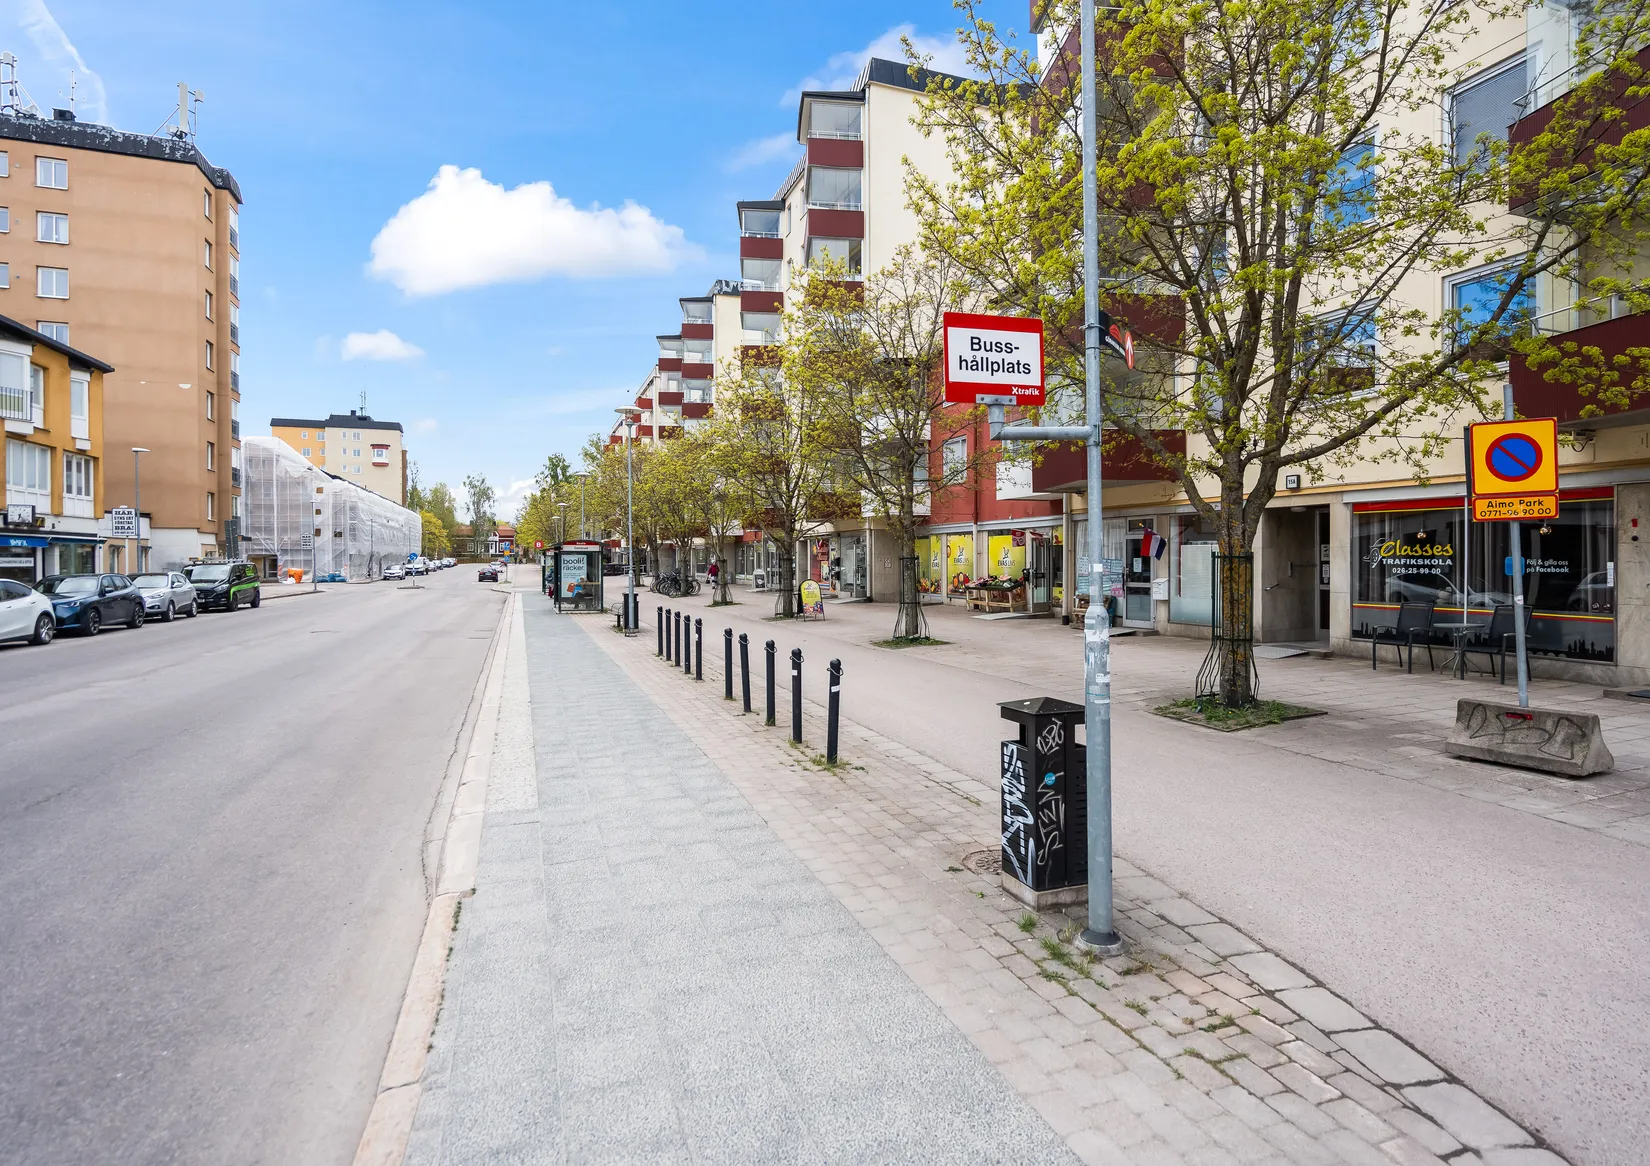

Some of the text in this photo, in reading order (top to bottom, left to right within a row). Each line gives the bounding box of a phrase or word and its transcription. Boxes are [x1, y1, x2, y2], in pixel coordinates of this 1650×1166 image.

[970, 336, 1020, 354] Buss-
[959, 354, 1032, 376] hållplats
[1011, 386, 1040, 396] Xtrafik
[1486, 498, 1545, 509] Aimo Park
[1480, 507, 1552, 517] 0771-96 90 00
[1380, 539, 1454, 557] Classes
[1381, 558, 1453, 566] TRAFIKSKOLA
